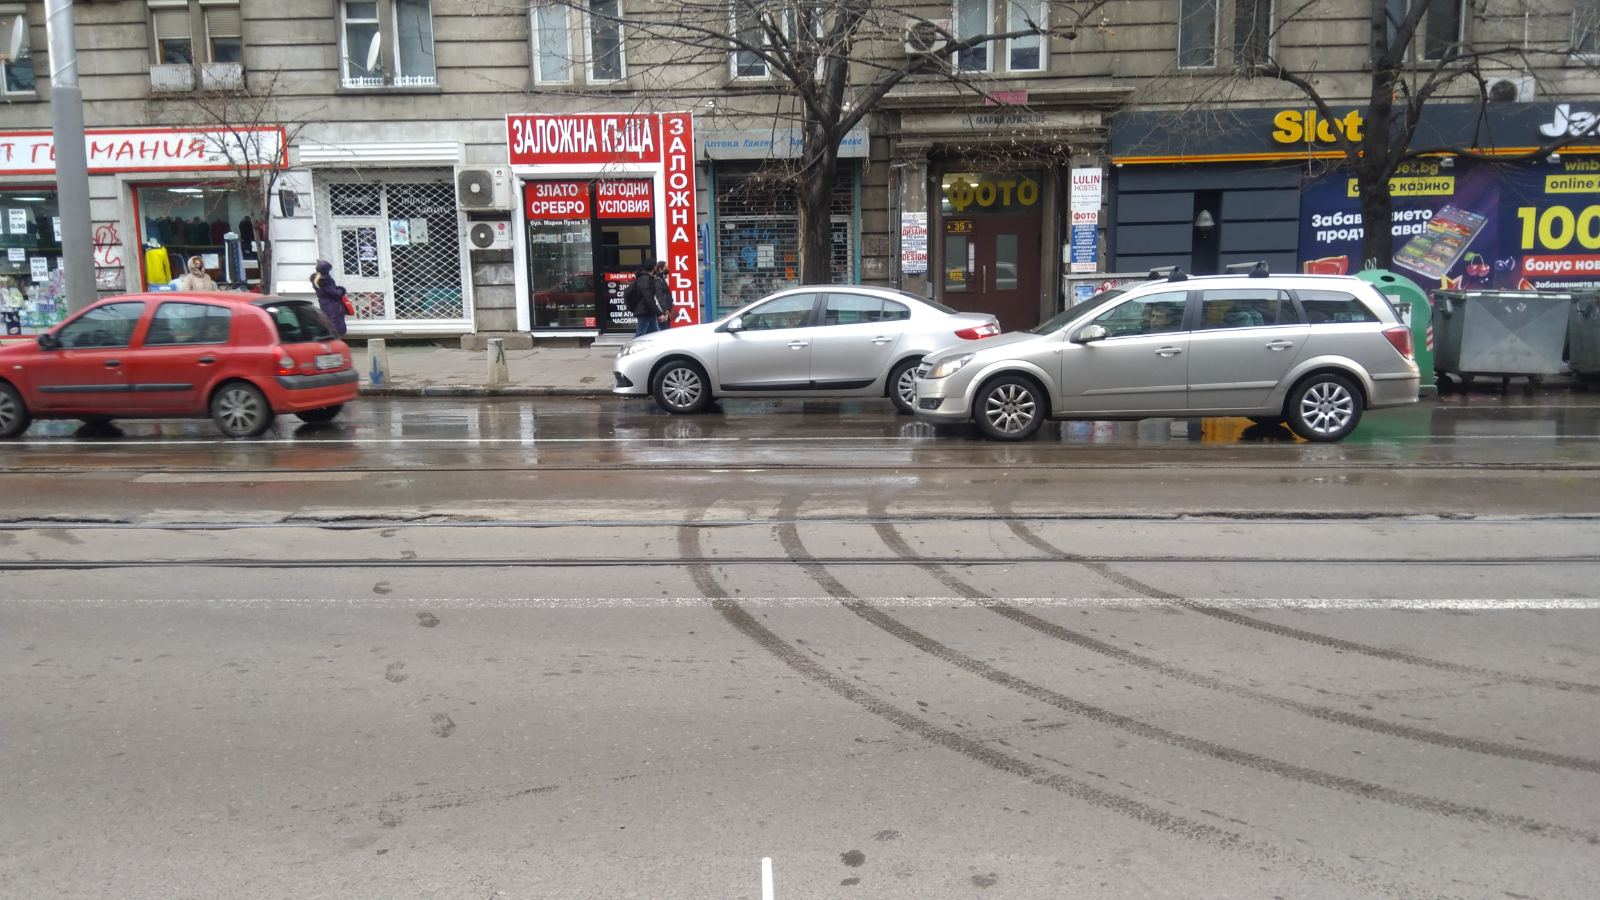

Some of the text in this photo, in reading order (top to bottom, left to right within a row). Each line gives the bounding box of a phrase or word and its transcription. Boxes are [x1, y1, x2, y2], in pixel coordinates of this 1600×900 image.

[1271, 109, 1364, 144] Slot
[512, 117, 654, 160] ЗАЛОЖНА КЪЩА
[31, 138, 206, 163] ГМАНИЯ
[1073, 175, 1100, 185] LULIN
[1399, 181, 1451, 192] казино
[1550, 177, 1595, 189] online
[536, 184, 579, 198] ЗЛАТО
[599, 182, 649, 197] ИЗГОДНИ
[947, 177, 1039, 212] ФОТО
[1074, 184, 1098, 192] HOSTEL
[531, 200, 585, 215] СРЕБРО
[599, 199, 650, 214] УСЛОВИЯ
[563, 219, 580, 227] Луиза
[669, 118, 695, 323] ЗАЛОЖНА КЪЩА
[1073, 212, 1096, 221] ФОТО
[954, 222, 965, 231] 35
[902, 253, 928, 262] DESIGN
[1525, 258, 1573, 274] бонус
